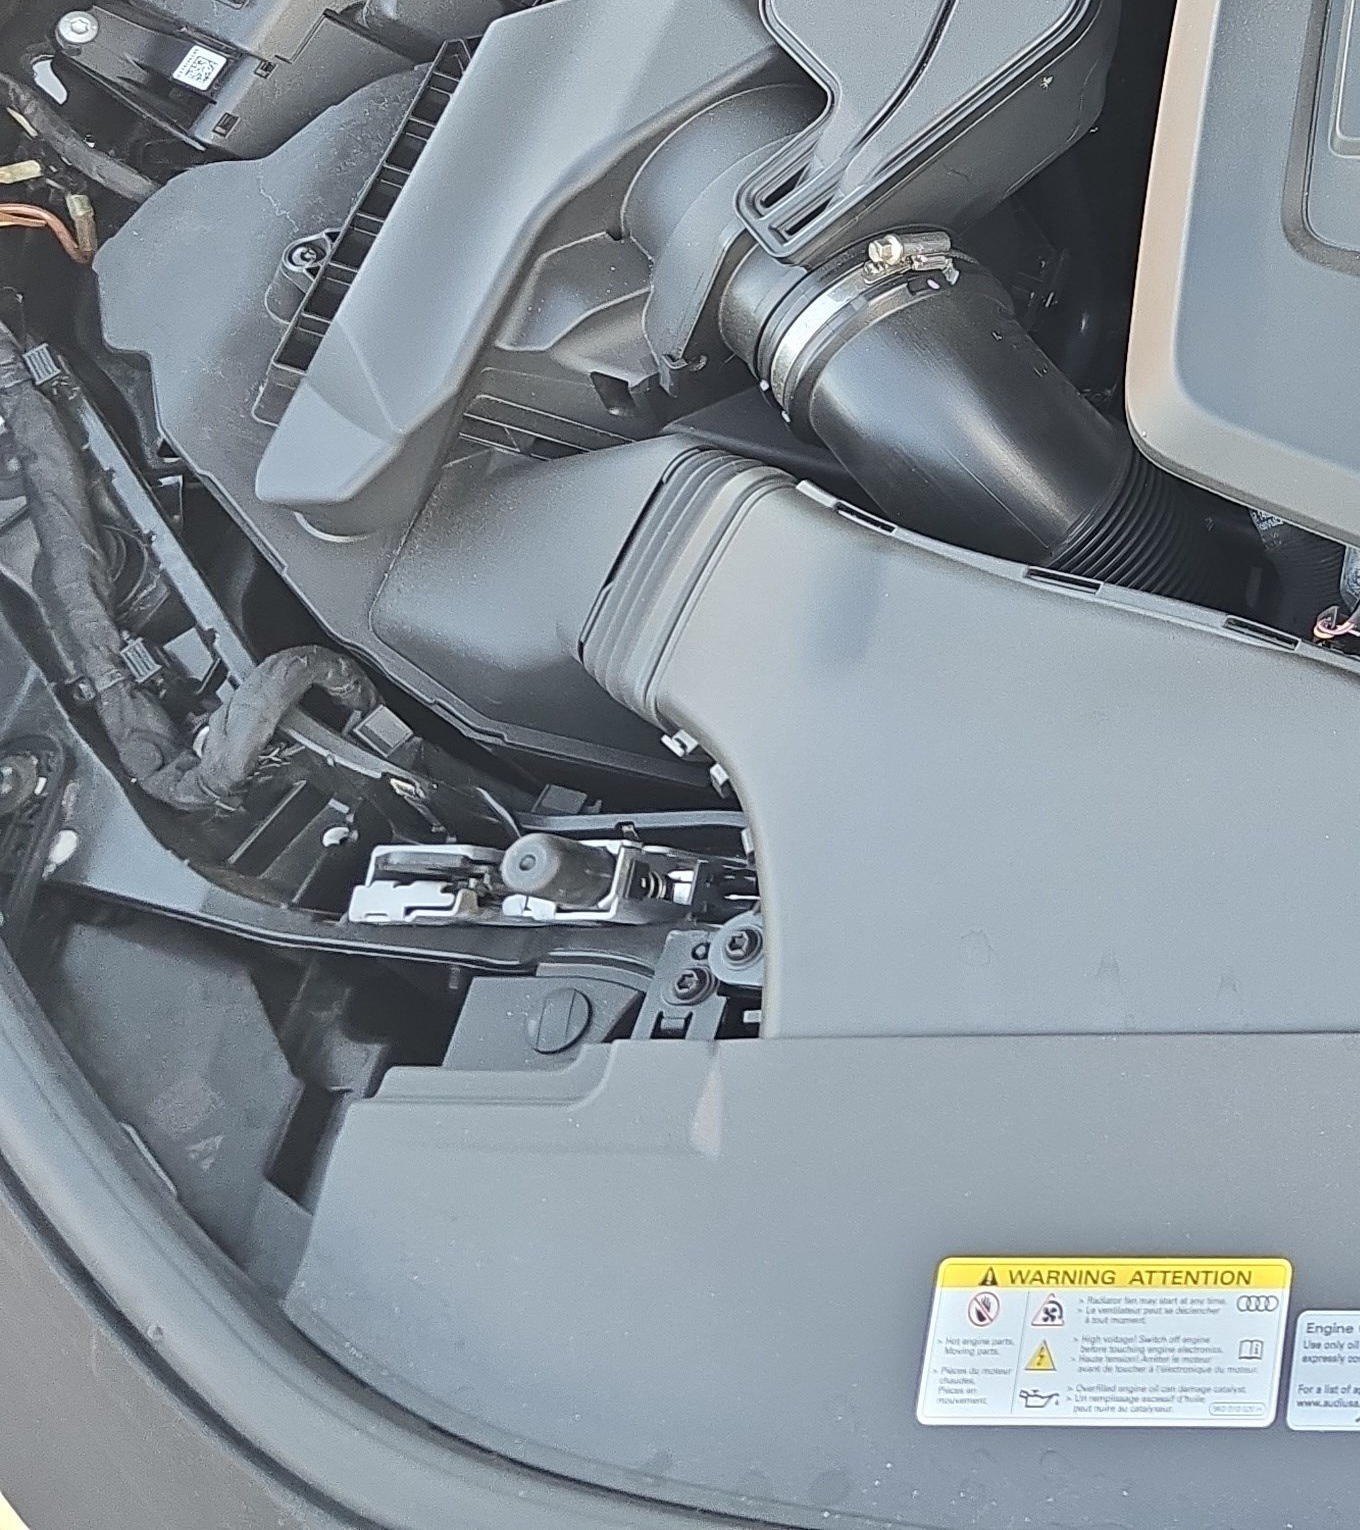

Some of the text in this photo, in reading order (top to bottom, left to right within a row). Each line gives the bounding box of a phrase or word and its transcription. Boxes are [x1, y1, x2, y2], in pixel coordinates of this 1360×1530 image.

[1008, 1269, 1253, 1286] WARNING ATTENTION
[1306, 1322, 1354, 1336] Engine
[1303, 1340, 1321, 1350] Use
[1323, 1340, 1344, 1352] only
[1347, 1340, 1359, 1350] oil
[1302, 1354, 1344, 1366] expressly
[1298, 1385, 1313, 1394] For
[1324, 1384, 1339, 1394] list
[1341, 1384, 1351, 1394] of
